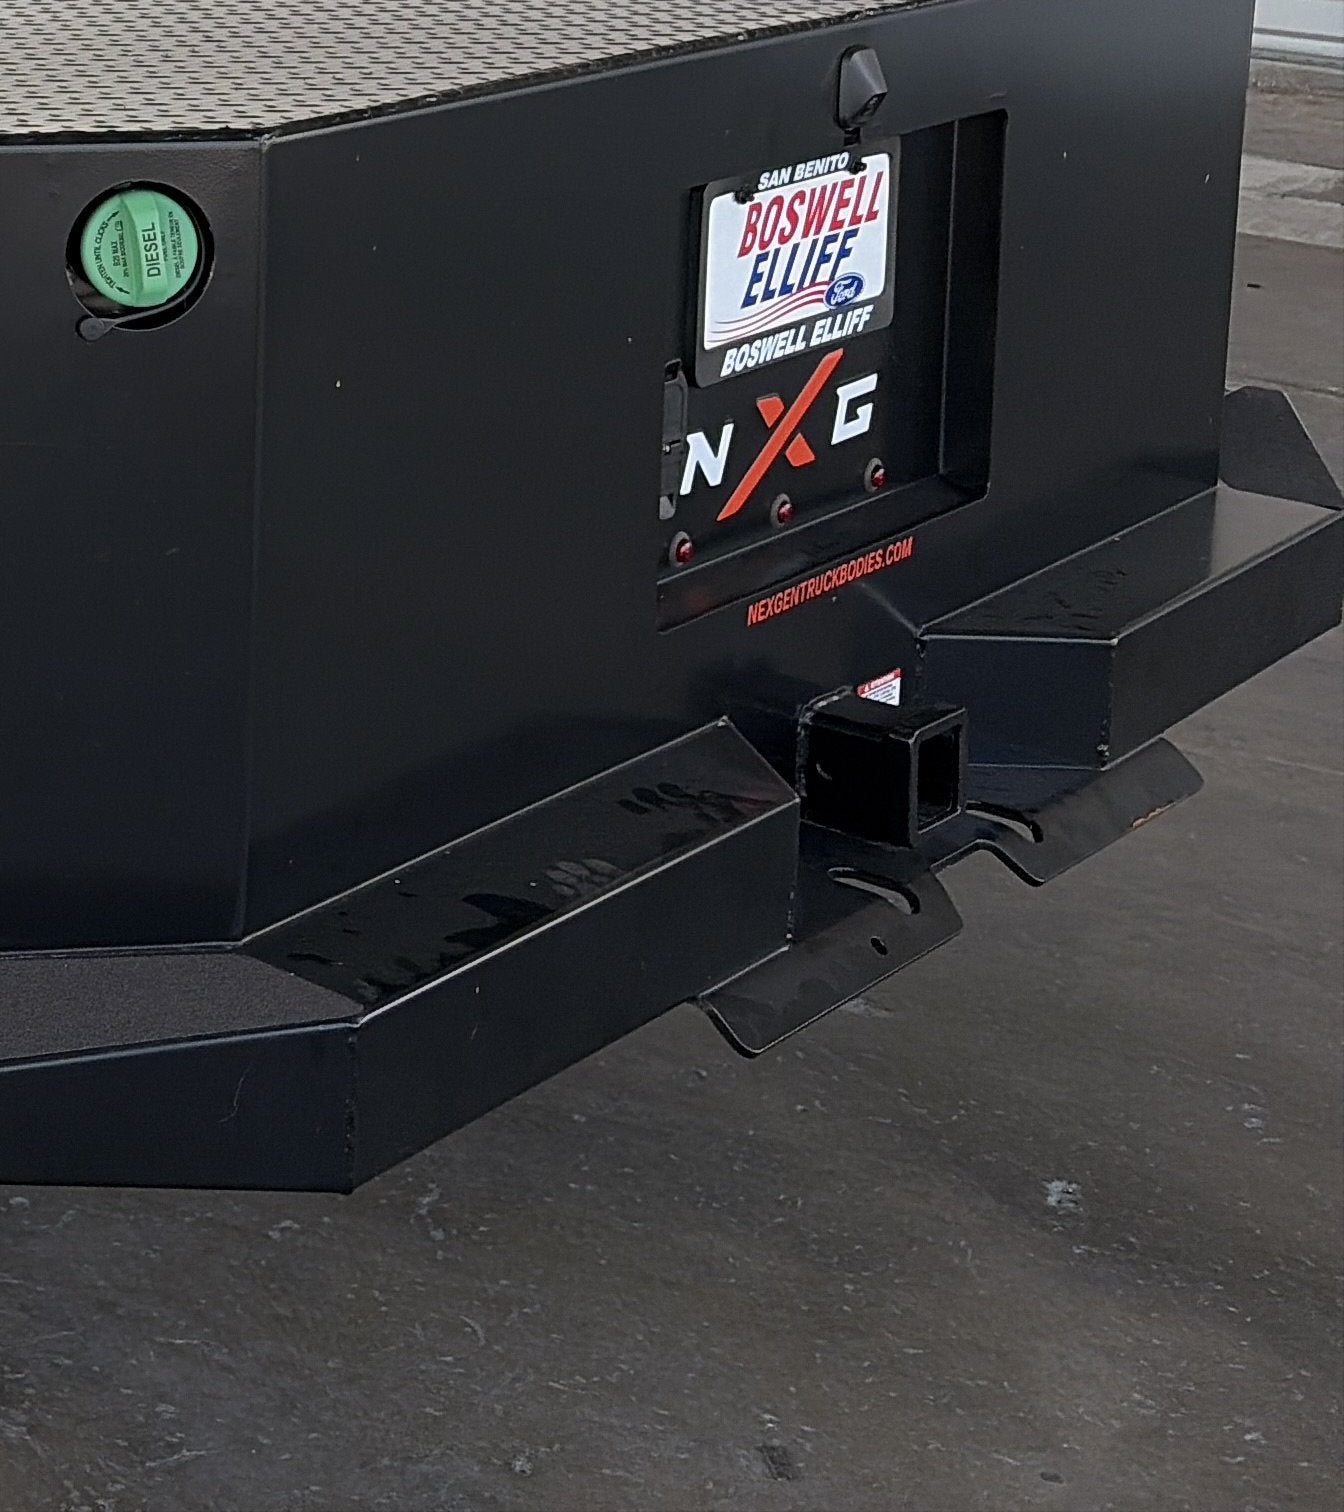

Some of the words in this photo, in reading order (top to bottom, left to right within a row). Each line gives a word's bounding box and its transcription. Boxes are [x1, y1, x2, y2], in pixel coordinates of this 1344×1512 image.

[758, 169, 791, 191] SAN
[793, 151, 850, 183] BENITO
[141, 222, 161, 278] DIESEL
[737, 171, 884, 258] BOSWELL
[740, 227, 860, 309] ELLIFF
[829, 278, 859, 307] Ford
[720, 324, 807, 377] BOSWELL
[809, 304, 875, 347] ELLIFF
[679, 348, 878, 521] NXG
[747, 536, 915, 626] NEXGENTRUCKBODIES.COM
